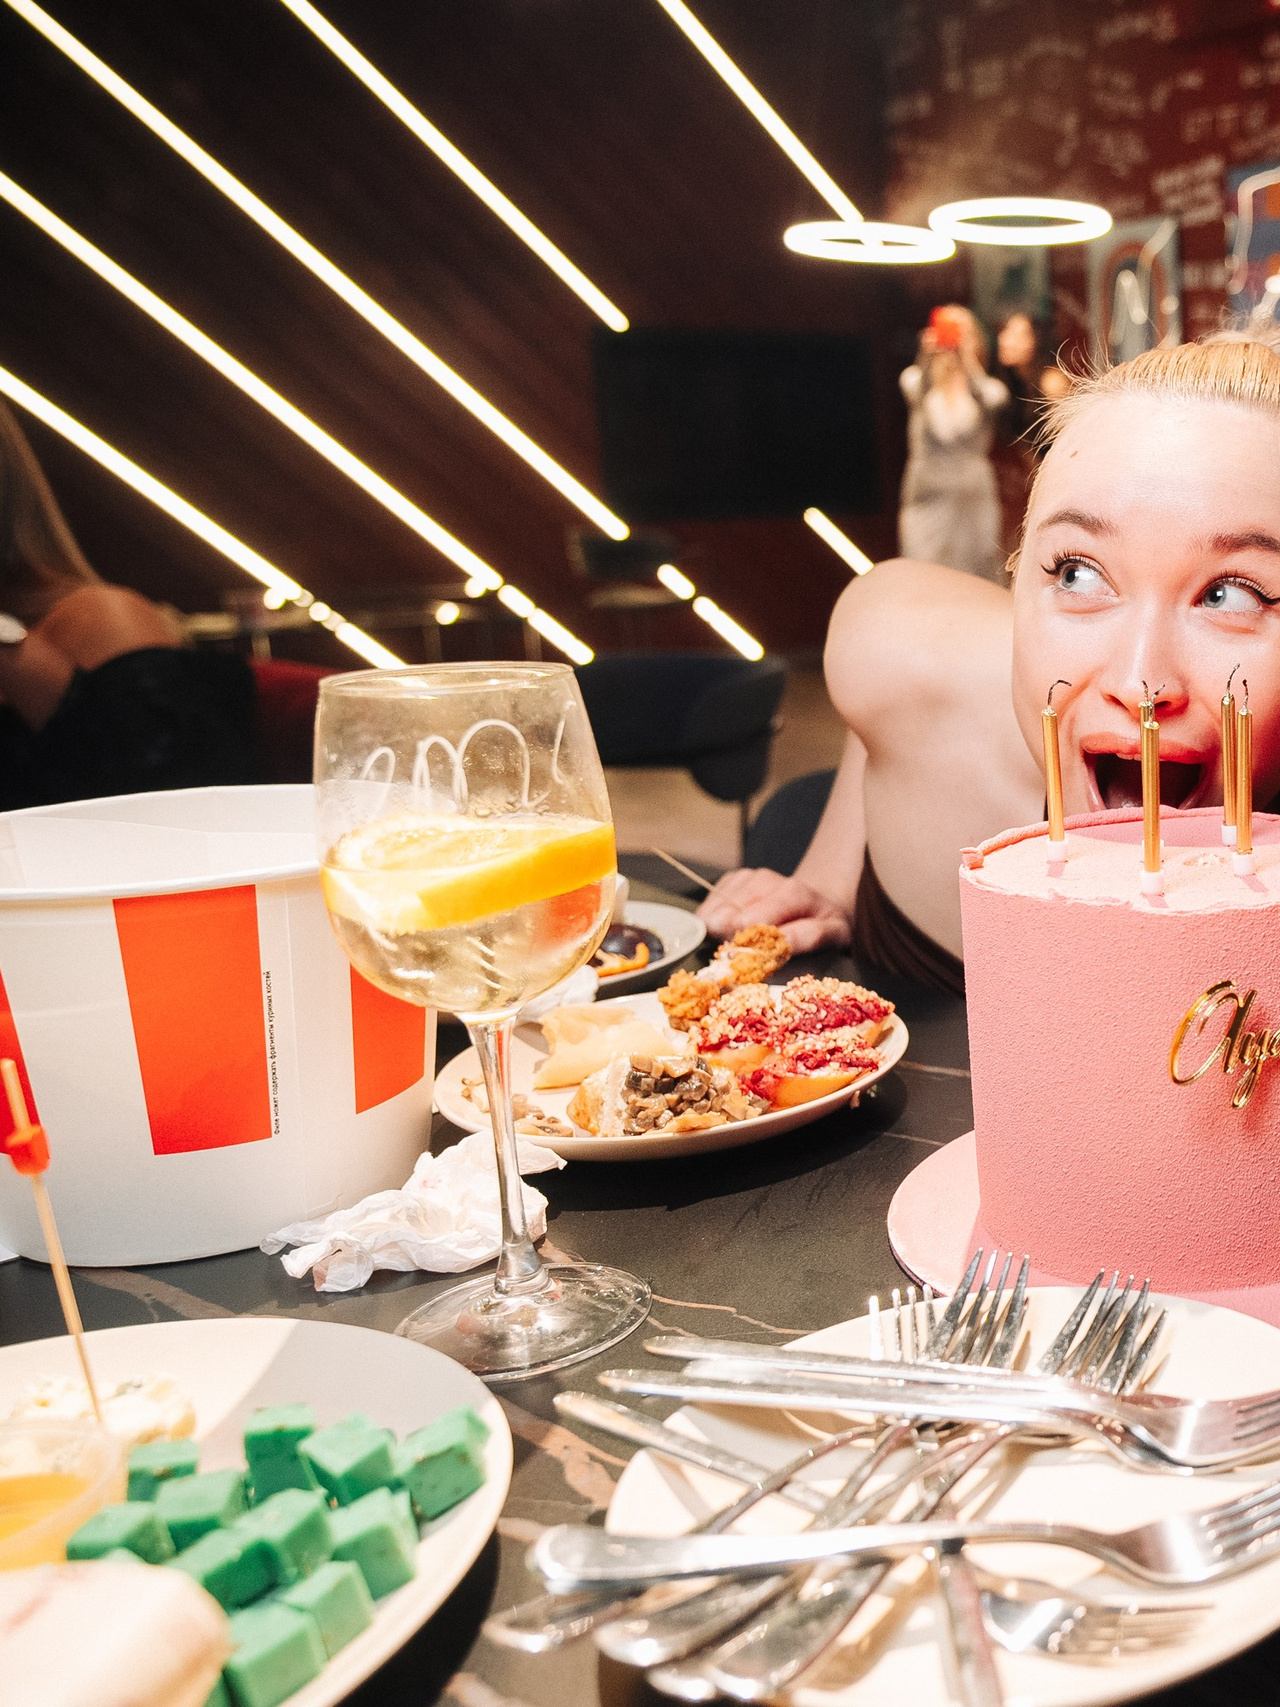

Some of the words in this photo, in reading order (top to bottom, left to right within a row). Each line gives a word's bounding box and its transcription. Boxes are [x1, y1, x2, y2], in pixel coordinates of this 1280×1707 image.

[263, 970, 272, 993] костей
[267, 994, 275, 1022] куриных
[269, 1023, 277, 1059] фрагменты
[272, 1097, 280, 1117] может
[273, 1118, 281, 1135] Филе
